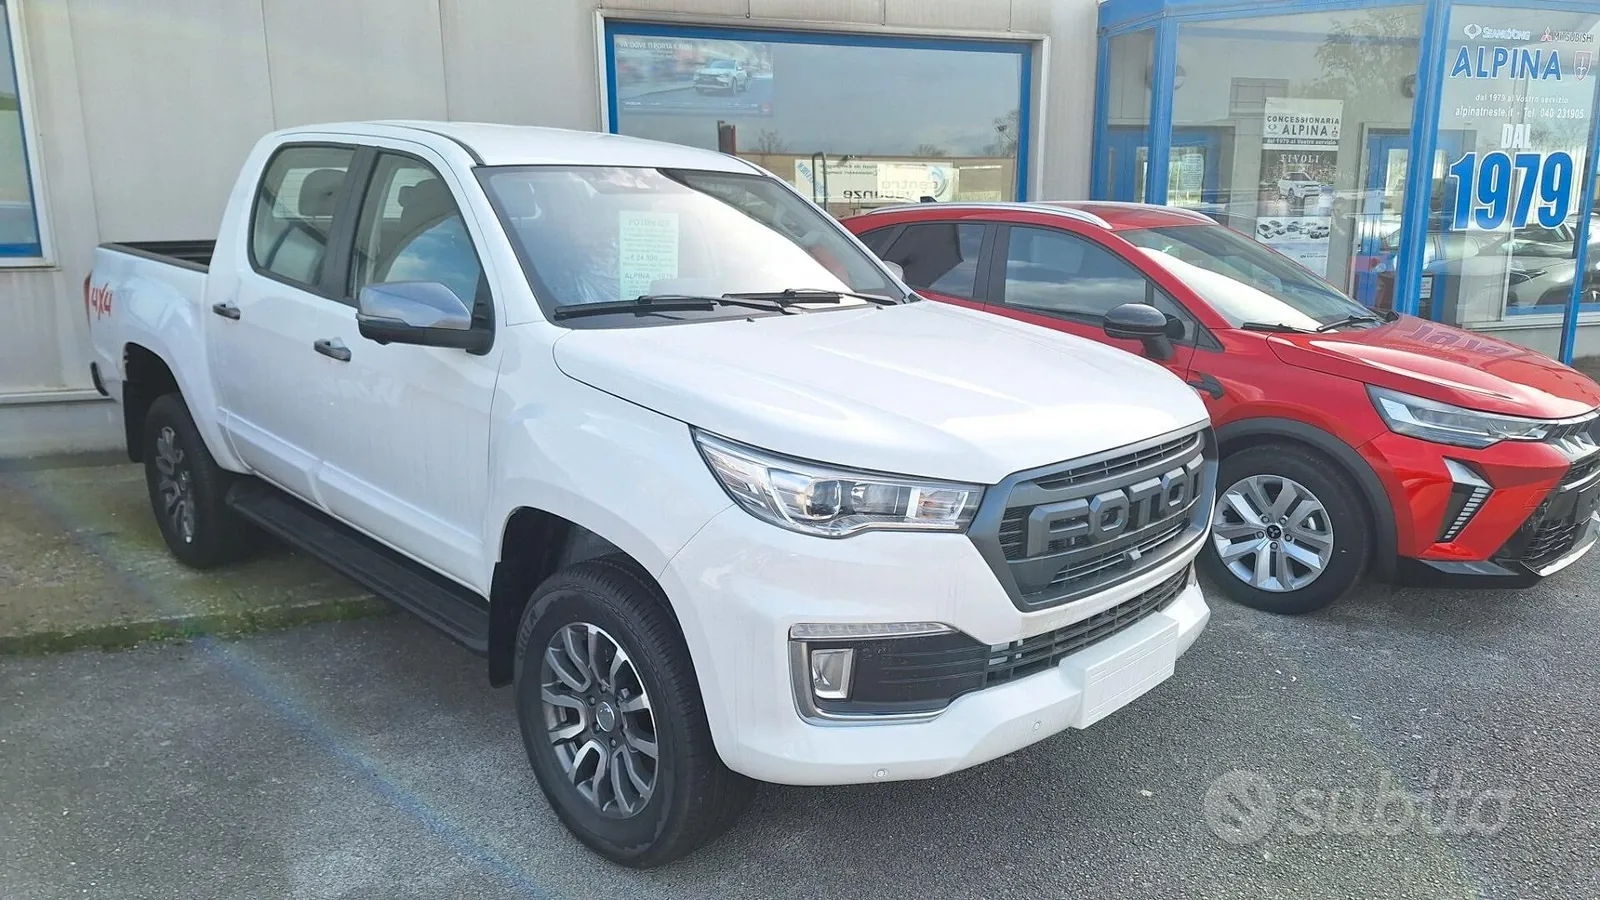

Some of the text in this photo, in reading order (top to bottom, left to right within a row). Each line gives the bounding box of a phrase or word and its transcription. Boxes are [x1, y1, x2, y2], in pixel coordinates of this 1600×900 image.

[1554, 30, 1594, 43] MITSUBISHI
[1450, 45, 1562, 81] ALPINA
[1475, 93, 1487, 101] dal
[1489, 93, 1505, 102] 1979
[1515, 94, 1539, 103] Vostro
[1540, 95, 1569, 104] servizio
[1455, 105, 1514, 118] alpinatrieste.it
[1540, 108, 1554, 119] 040
[1556, 108, 1585, 119] 231905
[1267, 115, 1339, 125] CONCESSIONARIA
[1282, 124, 1327, 136] ALPINA
[1281, 153, 1320, 164] TIVOLI
[1449, 150, 1574, 231] 1979
[1026, 452, 1205, 558] FOTON
